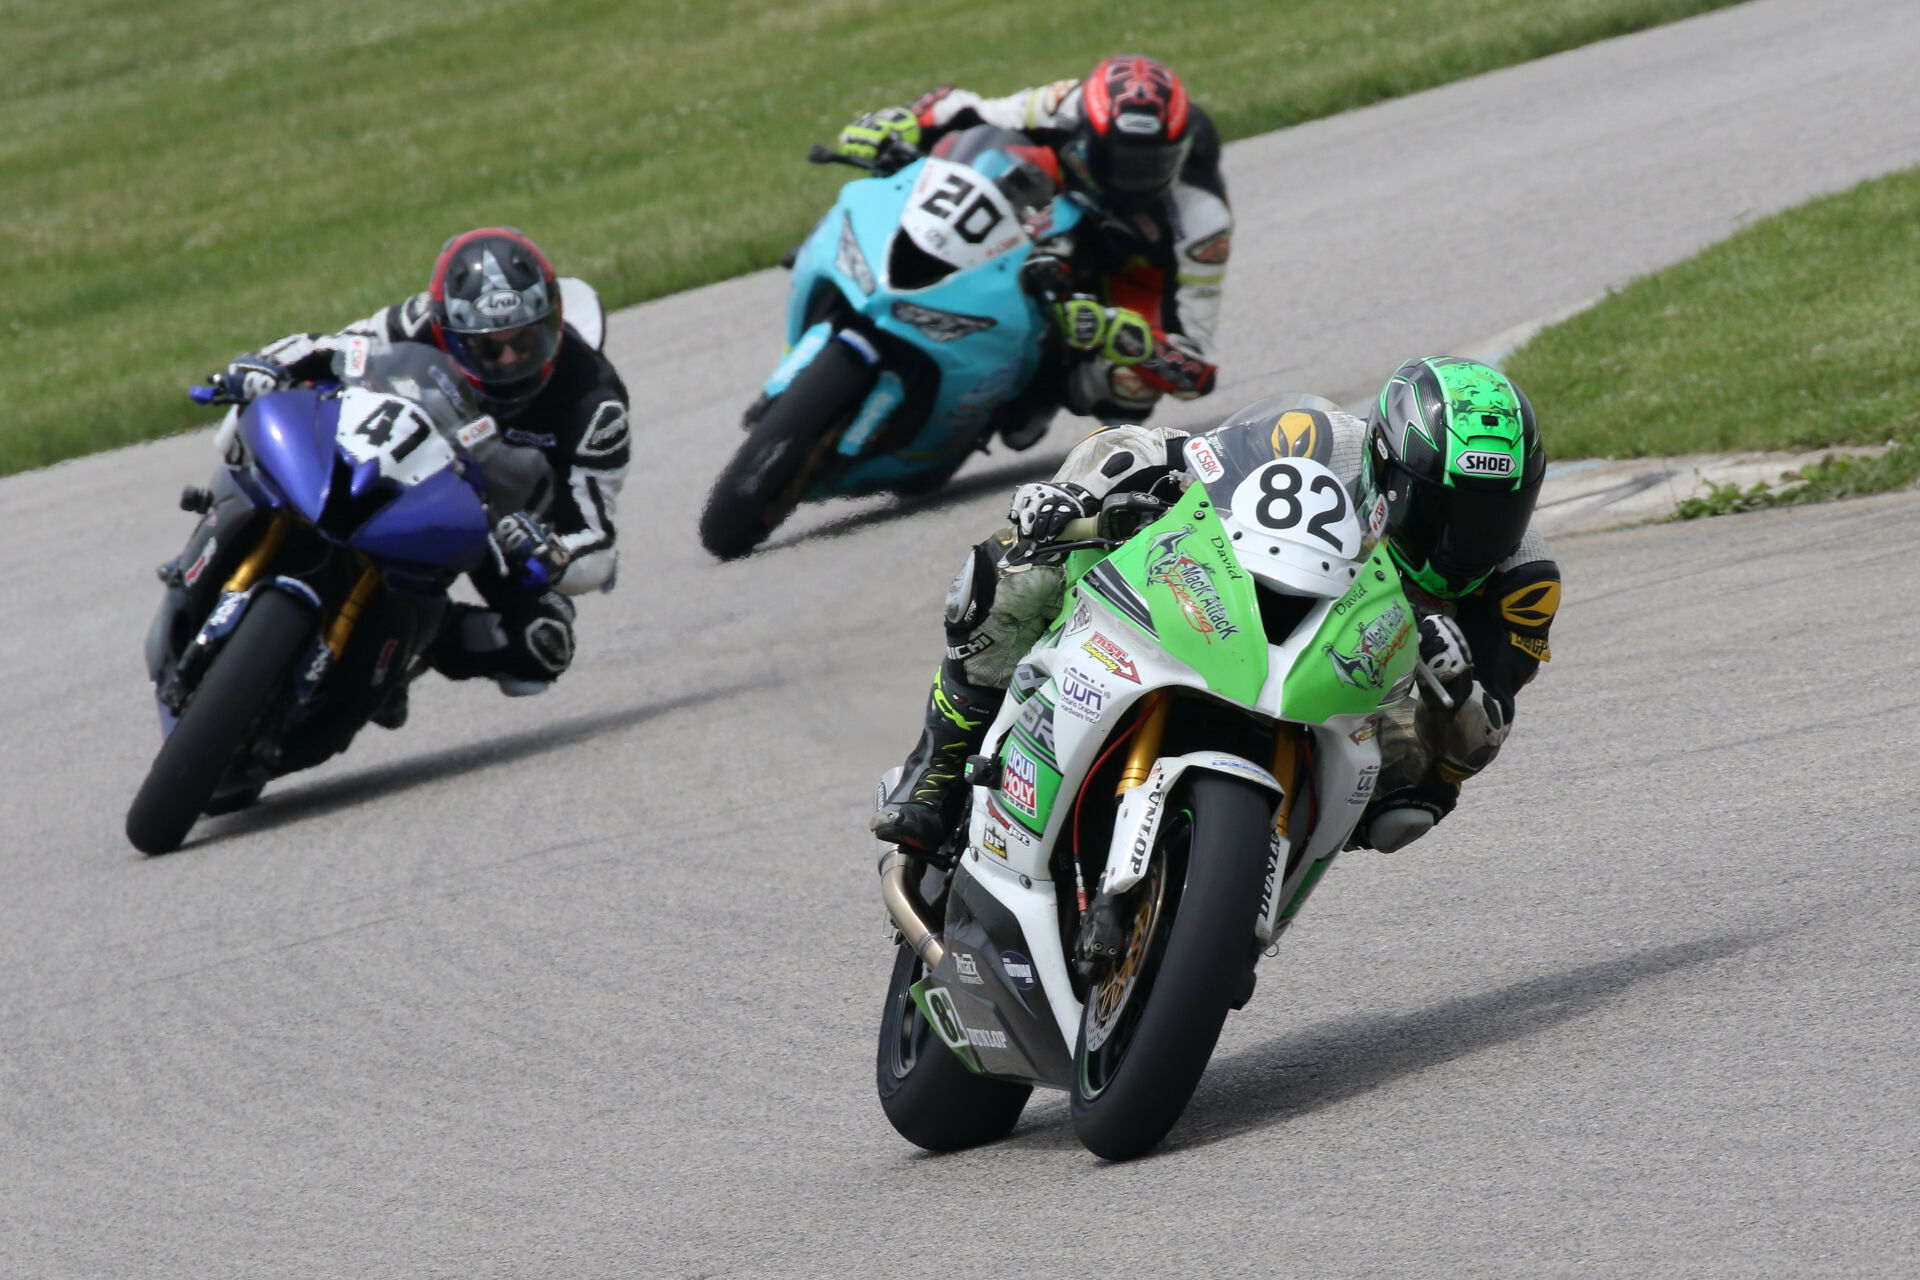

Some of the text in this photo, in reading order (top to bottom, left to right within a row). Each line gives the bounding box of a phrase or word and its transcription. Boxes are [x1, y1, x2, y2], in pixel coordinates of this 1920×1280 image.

[920, 174, 1004, 244] 20
[355, 399, 431, 464] 47
[1195, 449, 1222, 479] CSBK
[1466, 455, 1511, 473] SHOEI
[1256, 463, 1347, 553] 82
[1210, 536, 1243, 580] David
[1334, 583, 1368, 616] David
[1091, 632, 1128, 660] FAST
[1008, 745, 1034, 785] LIQUI
[1003, 772, 1034, 805] MOLY
